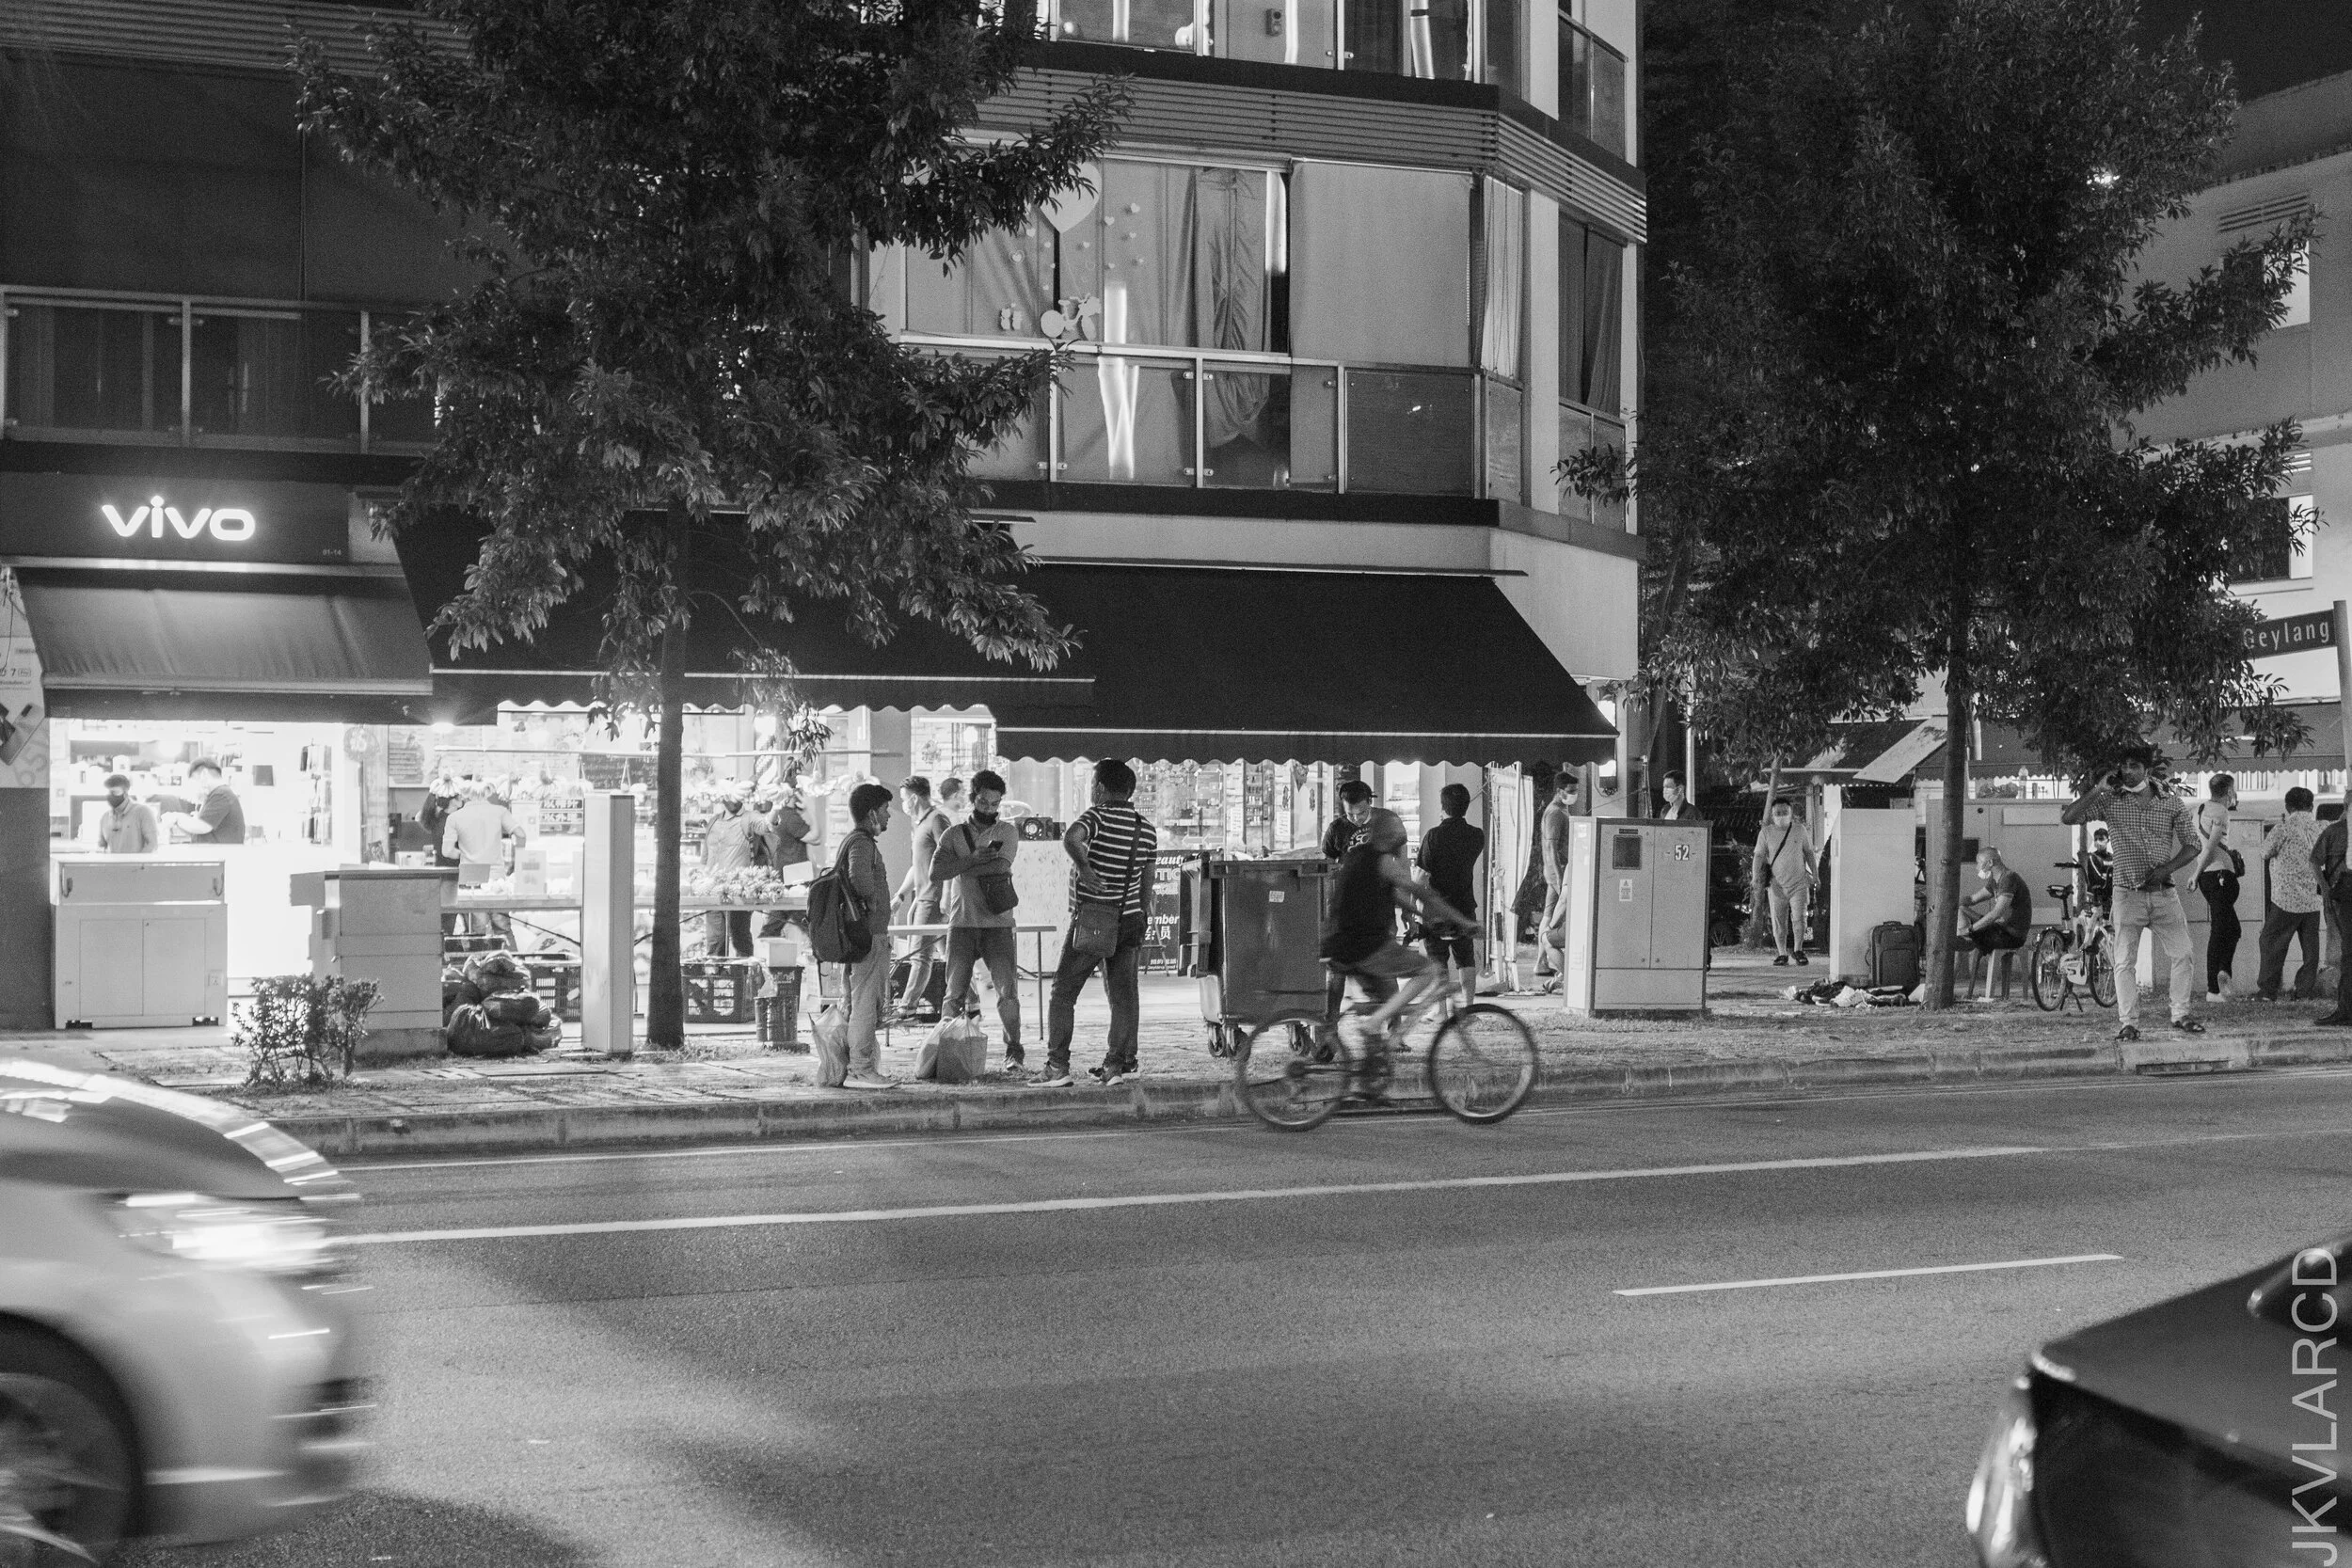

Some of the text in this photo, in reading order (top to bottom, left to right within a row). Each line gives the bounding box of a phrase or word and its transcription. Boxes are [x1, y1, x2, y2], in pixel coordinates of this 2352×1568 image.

[102, 495, 256, 541] vivo
[2243, 622, 2329, 651] Geylang
[1154, 854, 1184, 867] eauty
[1675, 845, 1689, 861] 52
[1148, 913, 1180, 924] ember
